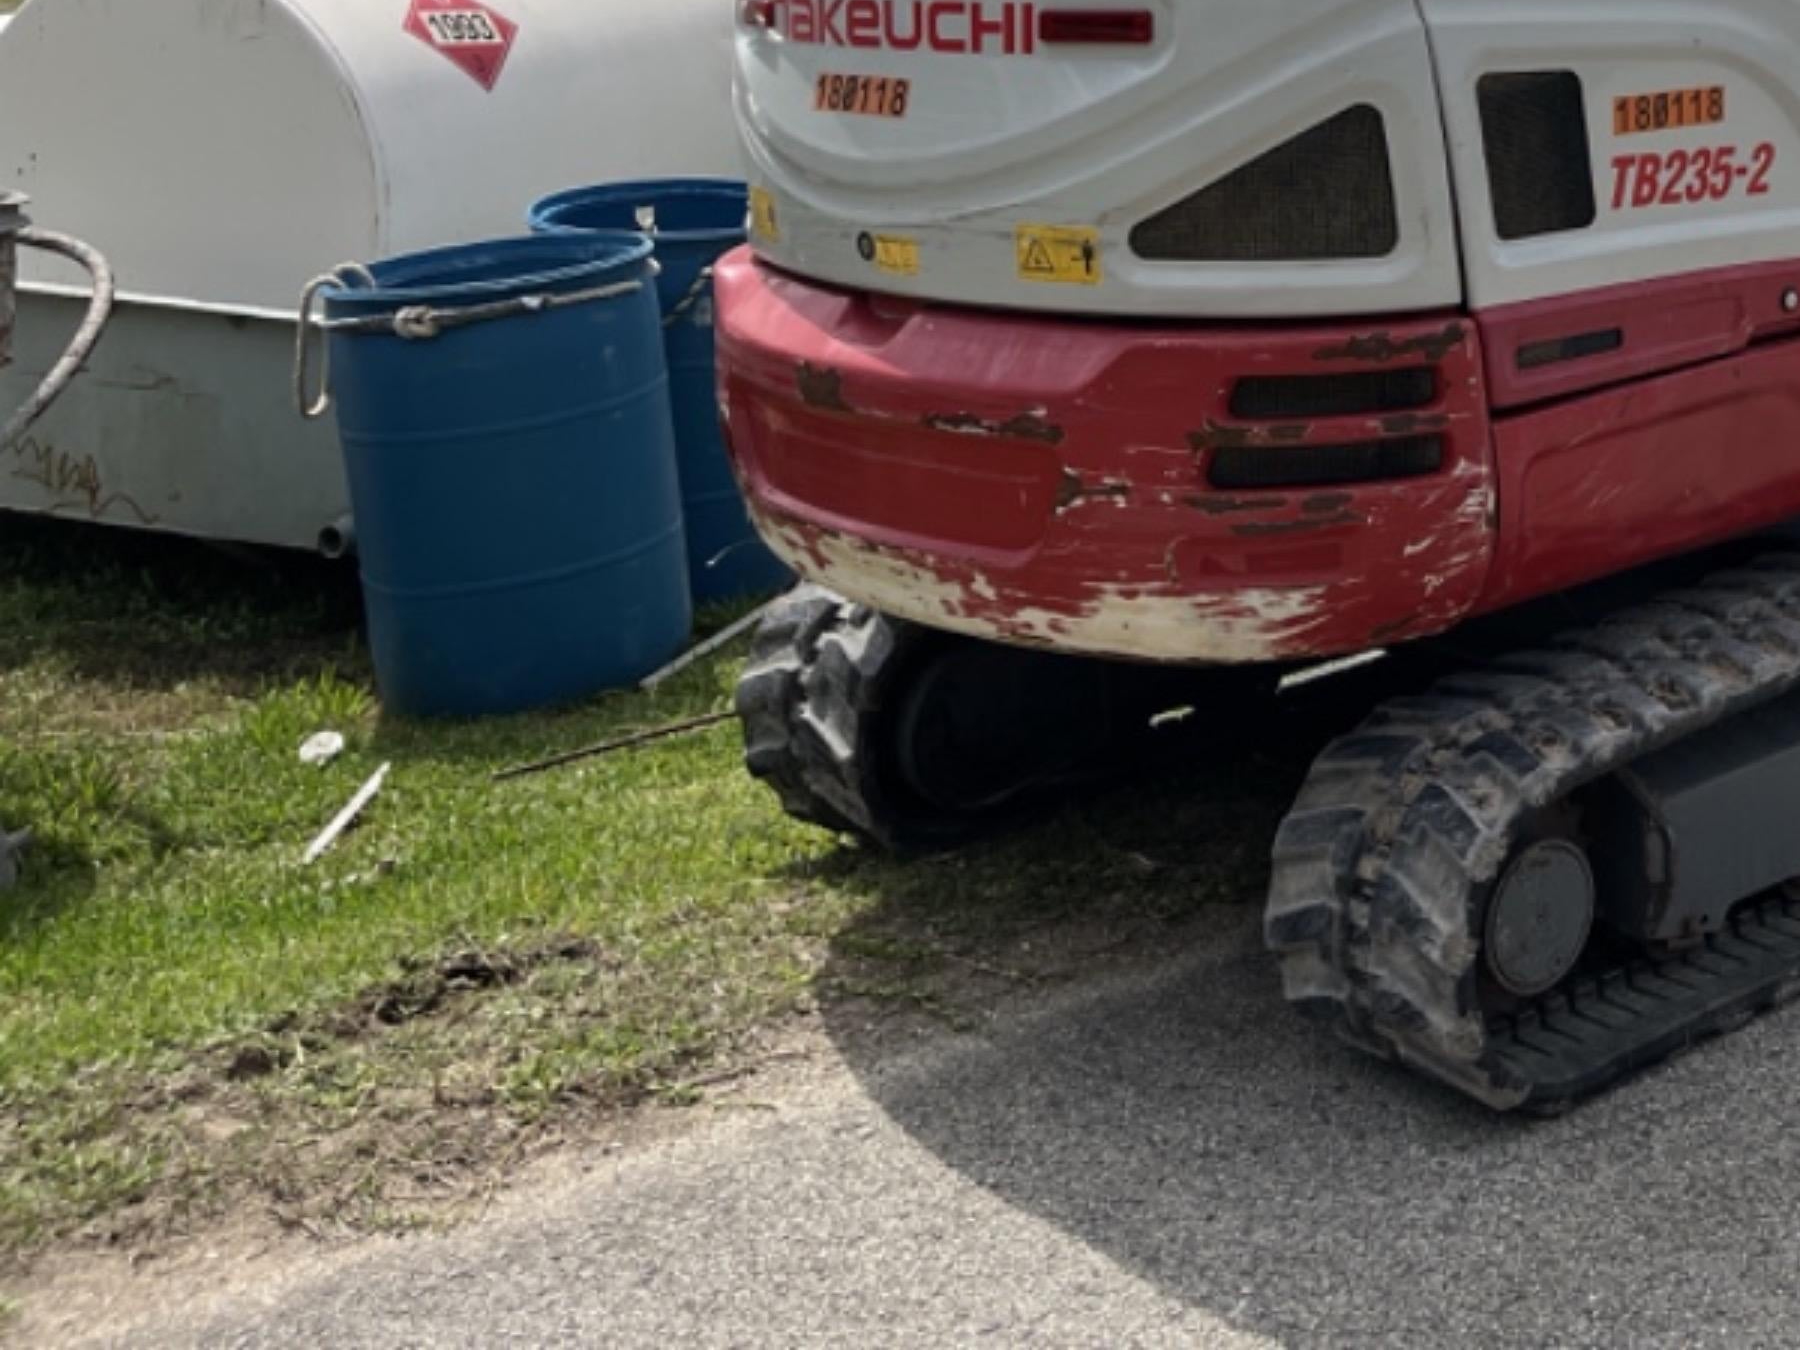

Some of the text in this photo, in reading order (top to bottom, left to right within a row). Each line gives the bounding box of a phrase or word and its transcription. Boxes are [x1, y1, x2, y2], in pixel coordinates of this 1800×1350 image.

[428, 14, 496, 41] 1993
[815, 73, 908, 116] 180118
[1615, 86, 1723, 134] 180118
[1611, 143, 1776, 210] TB235-2
